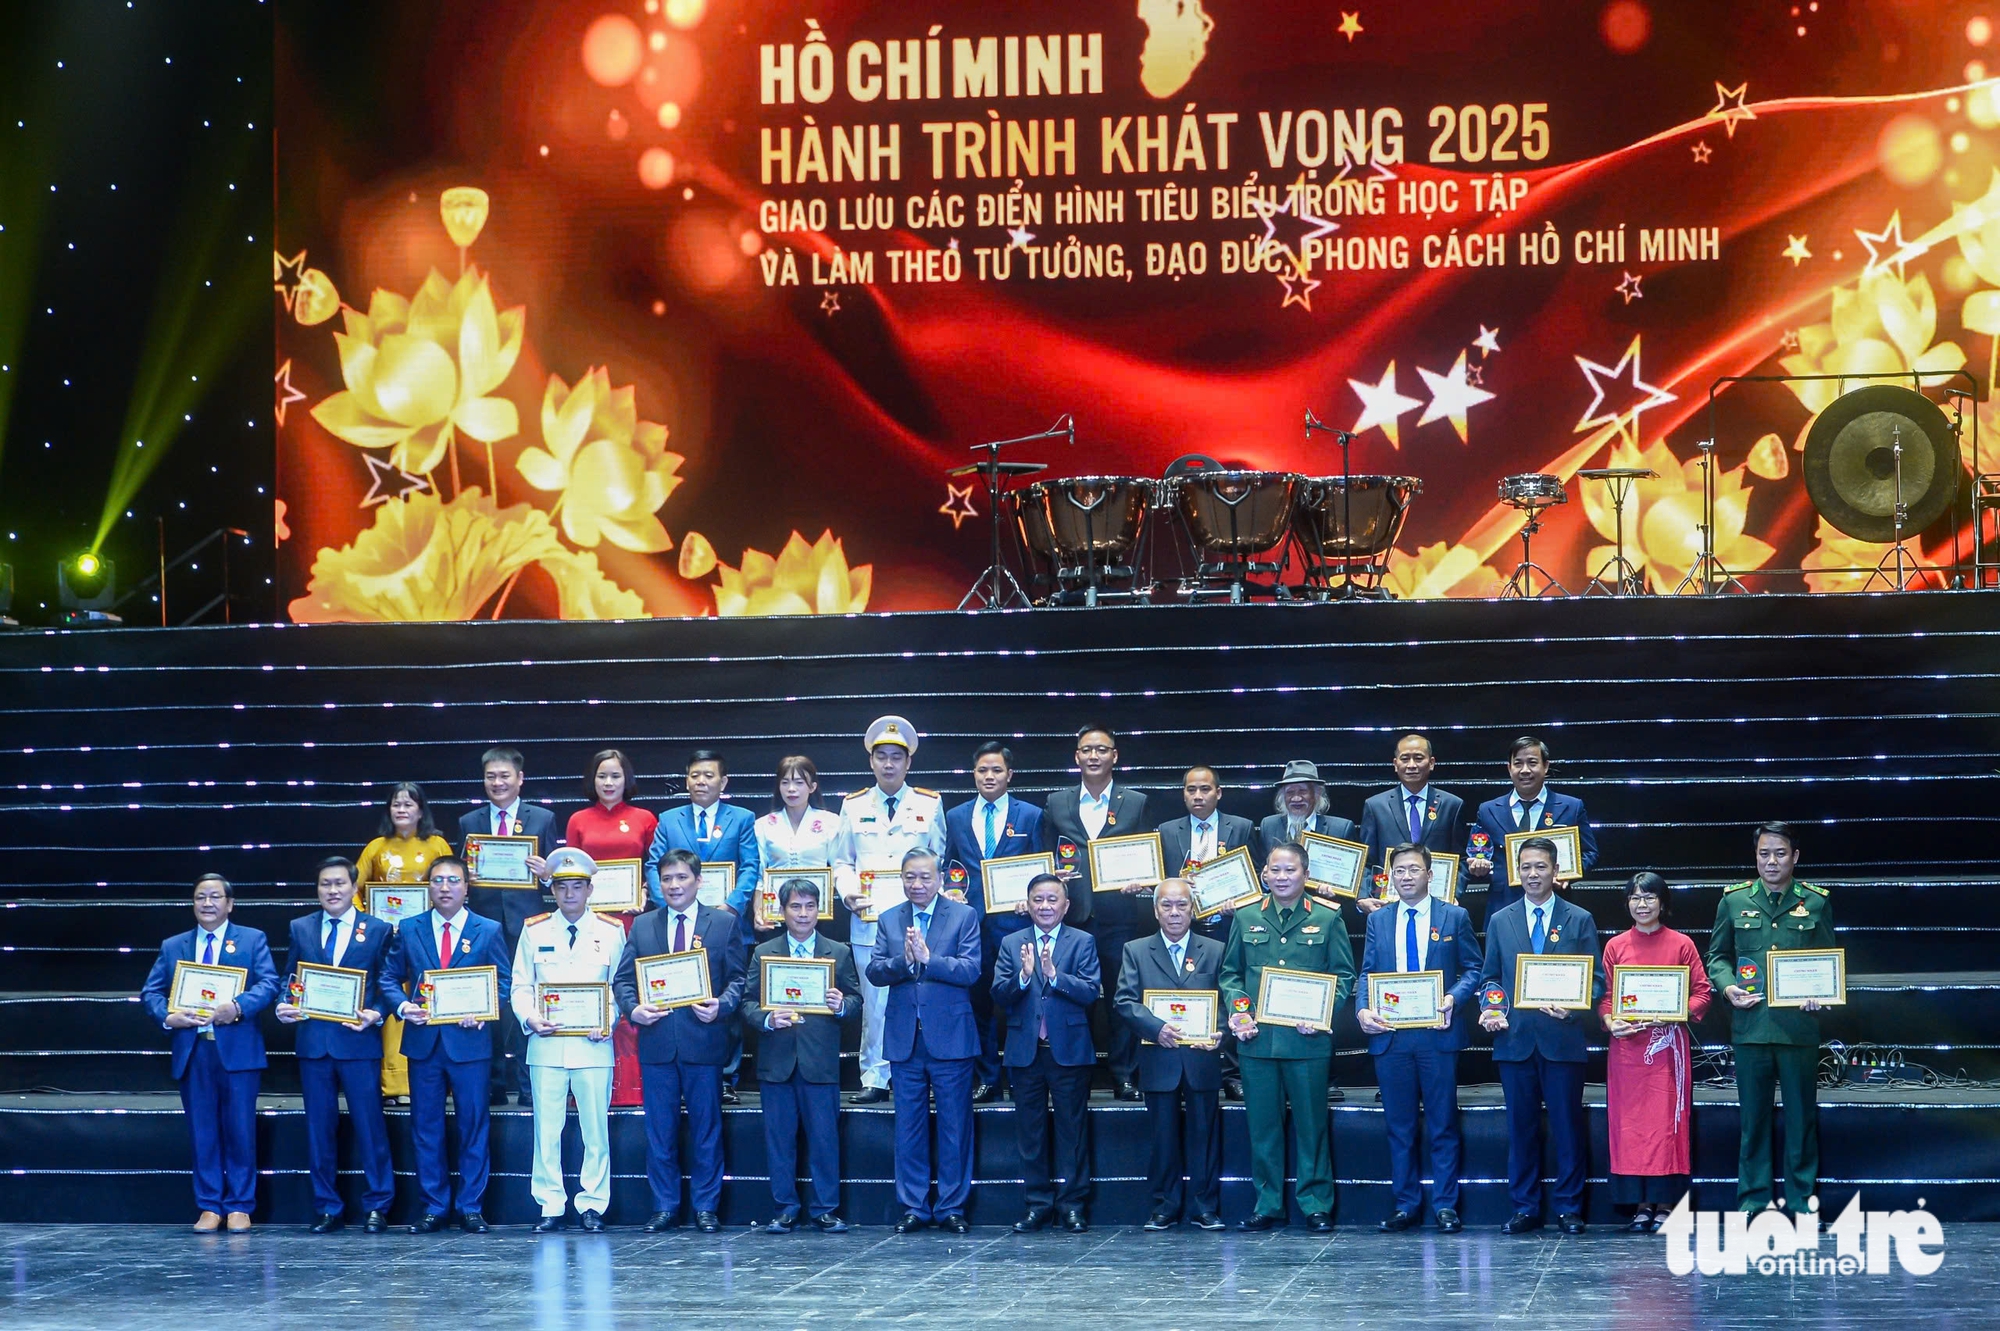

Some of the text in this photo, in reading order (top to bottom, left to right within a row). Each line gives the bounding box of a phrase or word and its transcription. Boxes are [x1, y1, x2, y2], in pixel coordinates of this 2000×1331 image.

[760, 18, 1102, 104] HỒ CHÍ MINH
[760, 103, 1550, 184] HÀNH TRÌNH KHÁT VỌNG 2025
[760, 171, 1529, 233] GIAO LƯU CÁC ĐIỂN HÌNH TIÊU BIỂU TRONG HỌC TẬP
[760, 247, 799, 286] VÀ
[812, 245, 874, 285] LÀM
[886, 249, 961, 283] THEO
[973, 244, 1013, 280] TƯ
[1025, 235, 1133, 281] TƯỞNG,
[1146, 242, 1206, 281] ĐẠO
[1306, 236, 1409, 271] PHONG
[1422, 228, 1505, 268] CÁCH
[1520, 221, 1560, 266] HỒ
[1575, 223, 1625, 263] CHÍ
[1640, 227, 1719, 262] MINH
